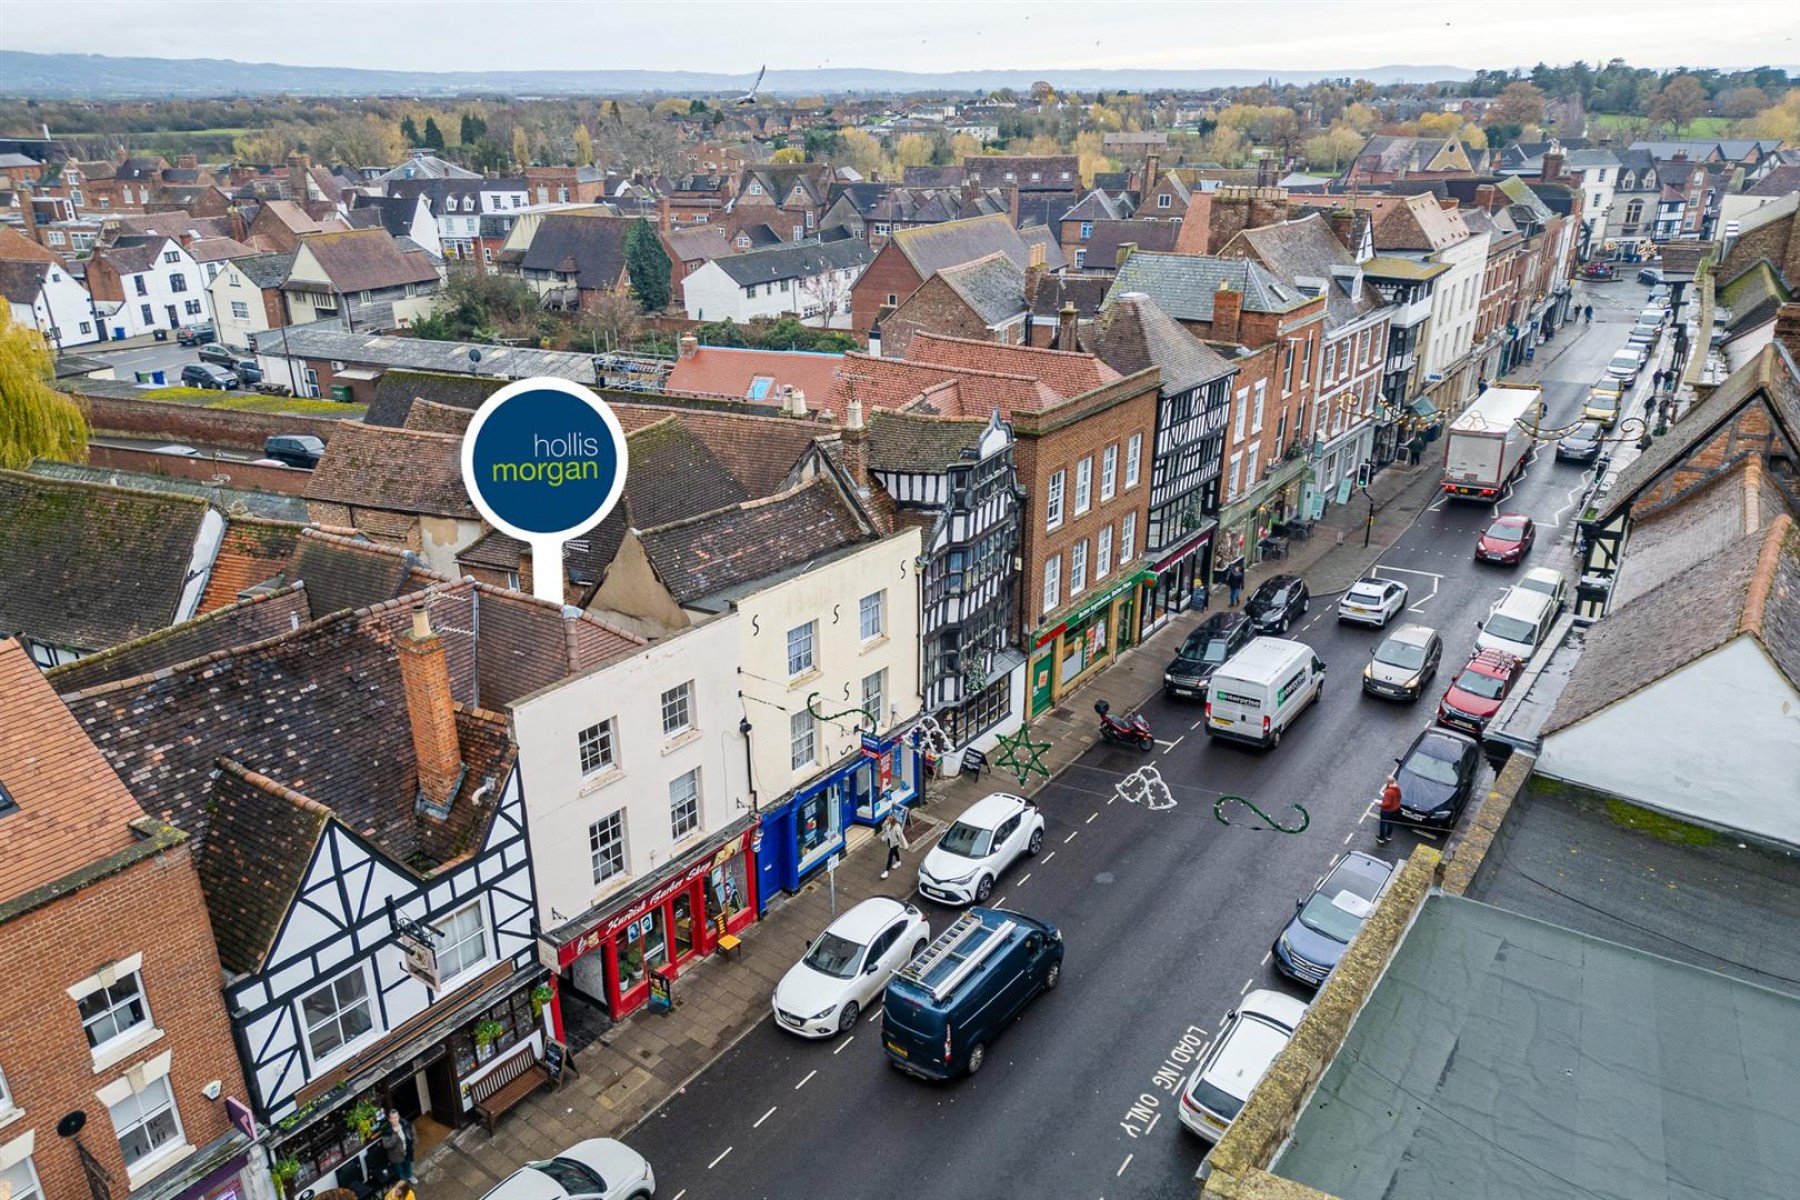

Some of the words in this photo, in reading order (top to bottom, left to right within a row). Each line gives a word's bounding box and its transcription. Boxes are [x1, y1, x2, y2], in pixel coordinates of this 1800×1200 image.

[649, 878, 684, 905] Barber
[686, 861, 712, 881] Shop
[1151, 1025, 1208, 1091] LOADING
[1119, 1093, 1160, 1139] ONLY
